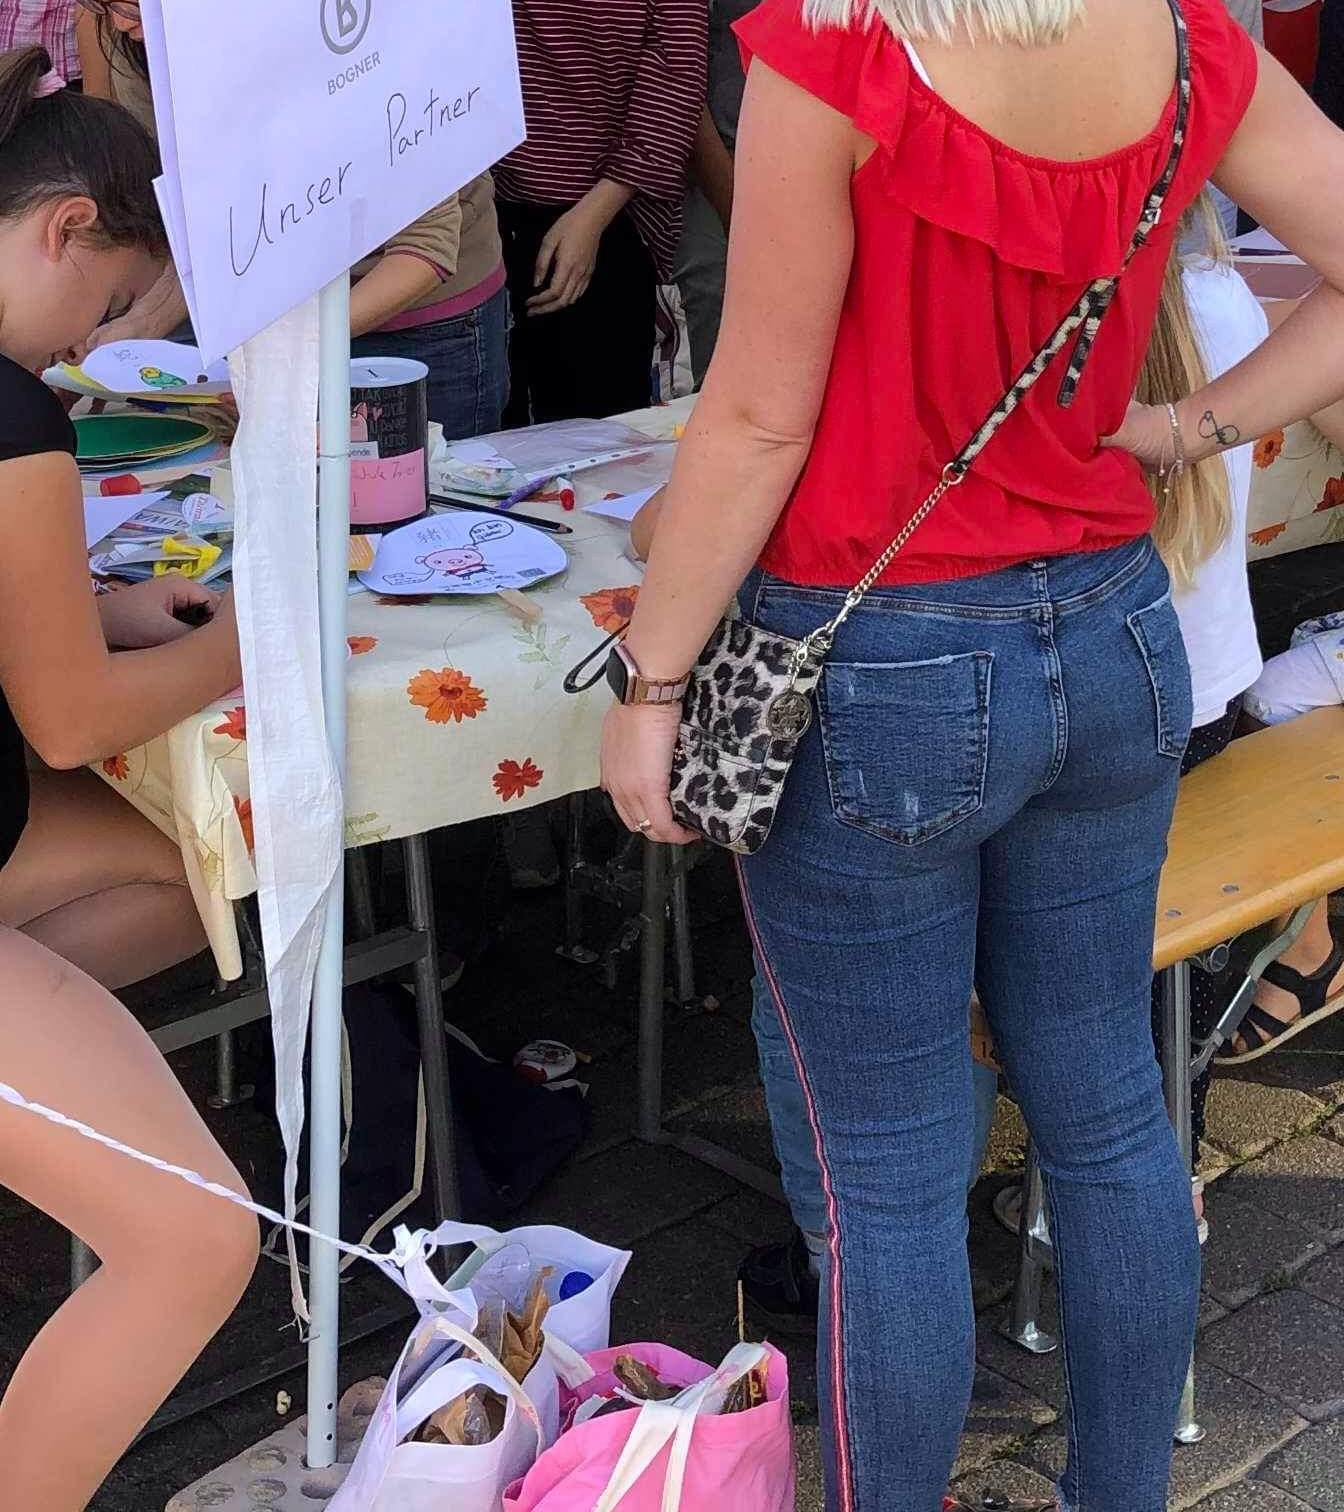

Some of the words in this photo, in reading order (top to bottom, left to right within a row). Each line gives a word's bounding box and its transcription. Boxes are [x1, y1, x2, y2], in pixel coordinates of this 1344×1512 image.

[326, 51, 384, 96] BOGNER
[229, 162, 353, 277] Unser
[385, 86, 481, 167] Partner
